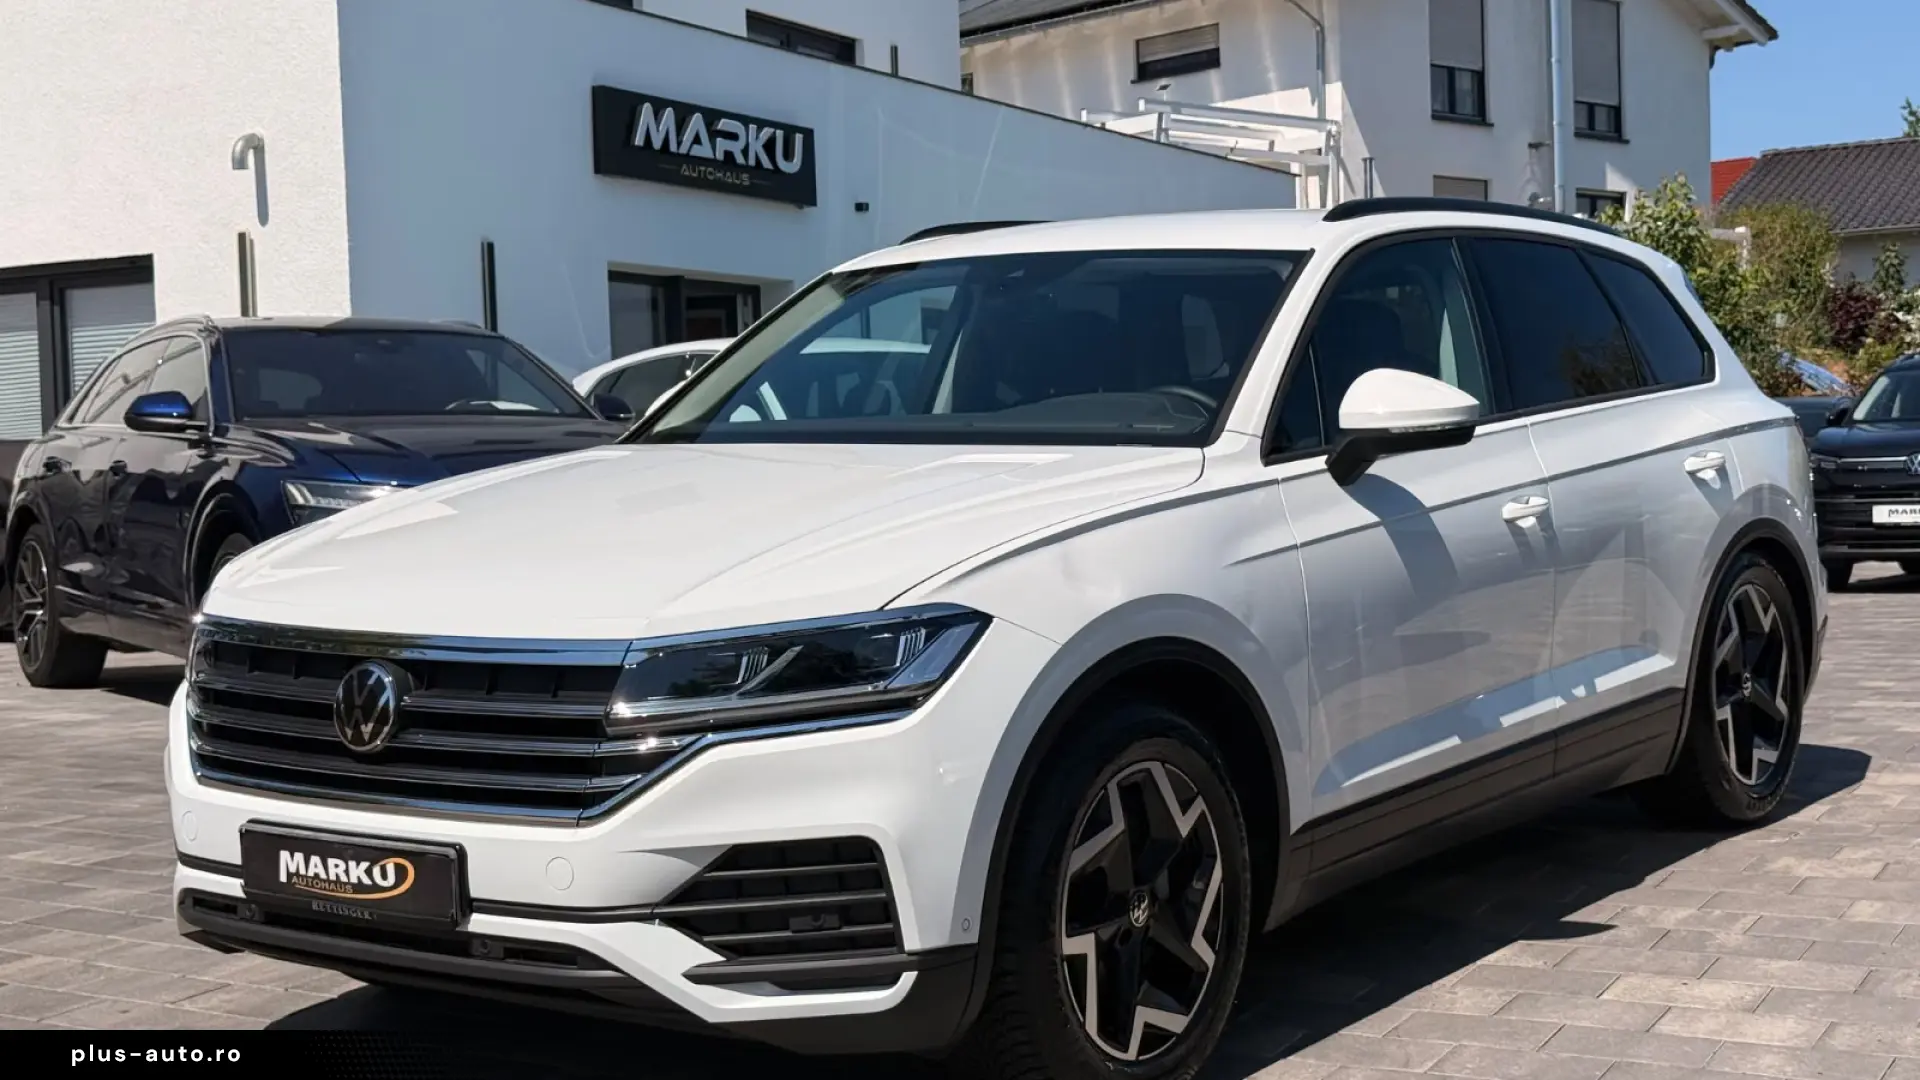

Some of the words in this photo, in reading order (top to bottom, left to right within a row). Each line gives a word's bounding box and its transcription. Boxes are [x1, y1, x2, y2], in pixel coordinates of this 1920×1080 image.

[633, 101, 804, 174] MARKU
[680, 163, 750, 186] AUTOHAUS
[1888, 508, 1920, 518] MAR
[279, 850, 396, 888] MARKU
[291, 876, 354, 894] AUTOHAUS
